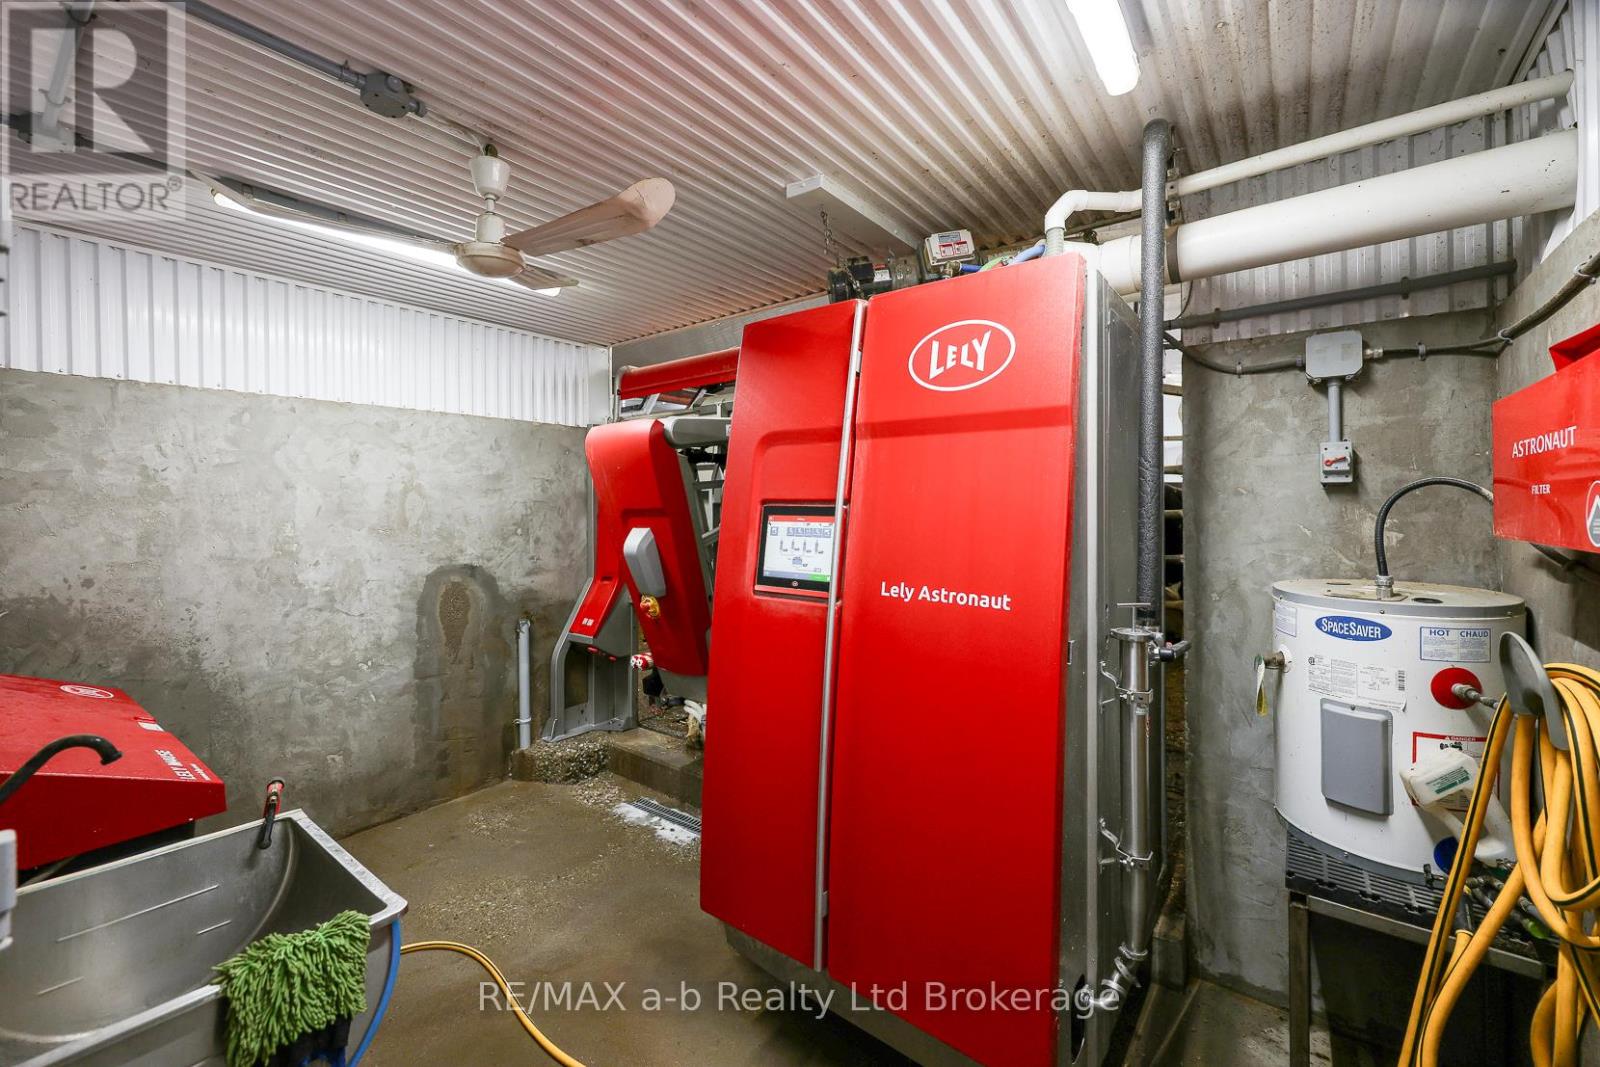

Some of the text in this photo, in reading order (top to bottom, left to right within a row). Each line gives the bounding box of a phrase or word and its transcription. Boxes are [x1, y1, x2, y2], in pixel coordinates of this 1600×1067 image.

[928, 330, 992, 380] LELY
[1511, 426, 1577, 458] ASTRONAUT
[1531, 484, 1551, 494] FILTER
[881, 581, 1012, 611] Lely Astronaut
[1429, 629, 1489, 638] HOT CHAUD
